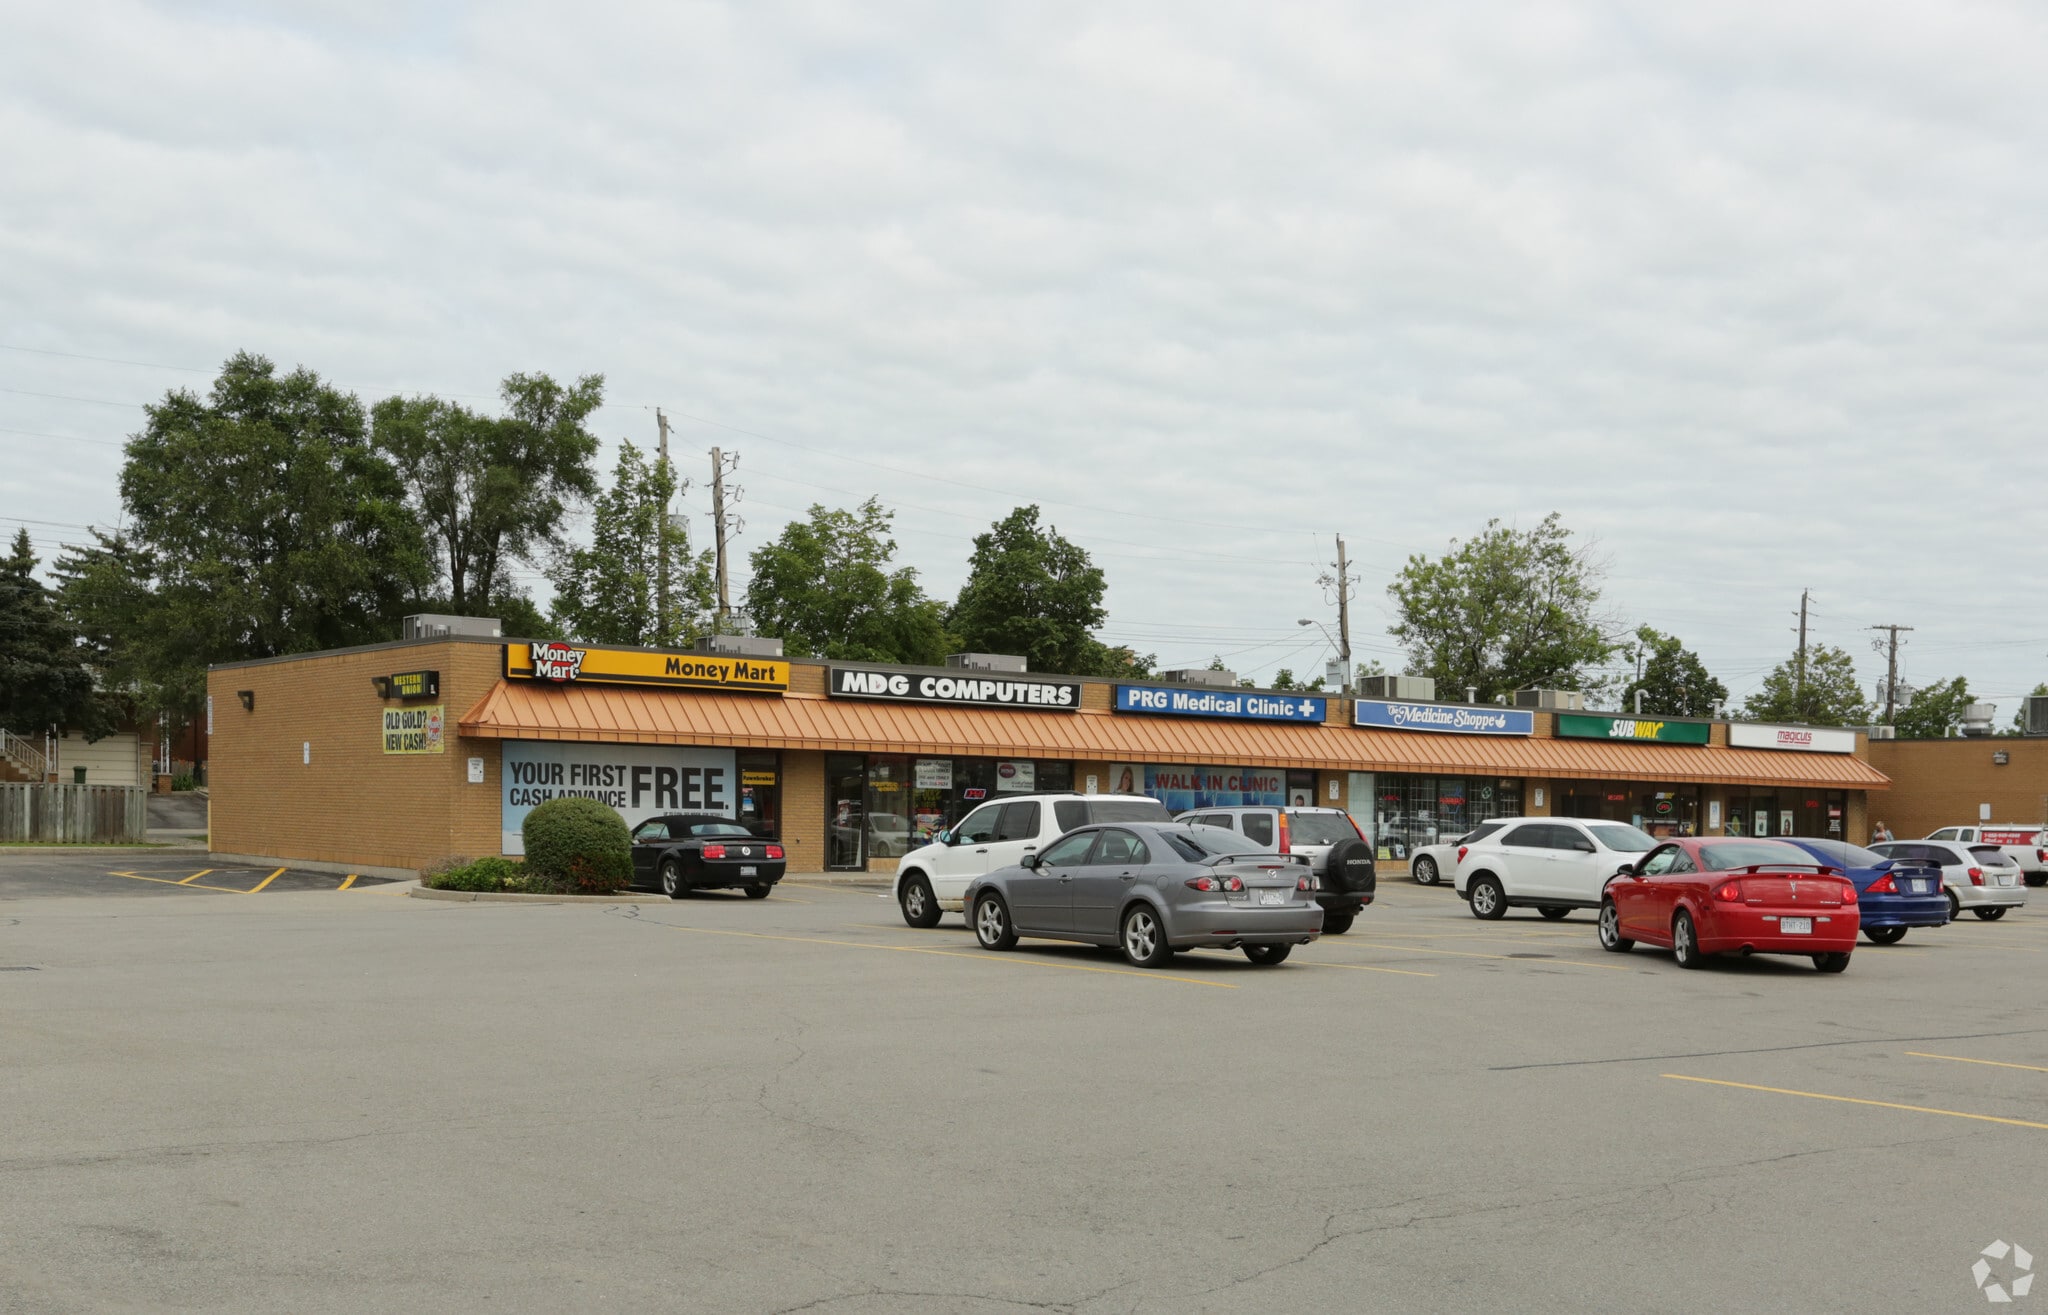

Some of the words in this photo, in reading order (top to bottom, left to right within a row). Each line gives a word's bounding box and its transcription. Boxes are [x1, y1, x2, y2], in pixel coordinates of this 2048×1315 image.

[531, 642, 585, 665] Money
[535, 660, 580, 679] Mart
[665, 657, 729, 683] Money
[734, 661, 775, 681] Mart
[393, 674, 422, 686] WESTERN
[841, 671, 909, 696] MDG
[920, 677, 1072, 706] COMPUTERS
[401, 684, 422, 696] UNION
[1128, 688, 1167, 708] PRG
[1172, 692, 1241, 713] Medical
[1246, 696, 1294, 717] Clinic
[385, 712, 401, 730] OLD
[402, 710, 427, 729] GOLD?
[1393, 706, 1453, 725] Medicine
[1453, 710, 1495, 730] Shoppe
[1609, 719, 1664, 738] SUBWAY
[1777, 730, 1812, 743] magicuts
[385, 734, 403, 751] NEW
[403, 733, 427, 751] CASH!
[510, 762, 564, 786] YOUR
[570, 764, 626, 787] FIRST
[1155, 774, 1202, 790] WALK
[1207, 775, 1223, 790] IN
[1228, 776, 1278, 792] CLINIC
[510, 788, 553, 806] CASH
[631, 766, 729, 810] FREE.
